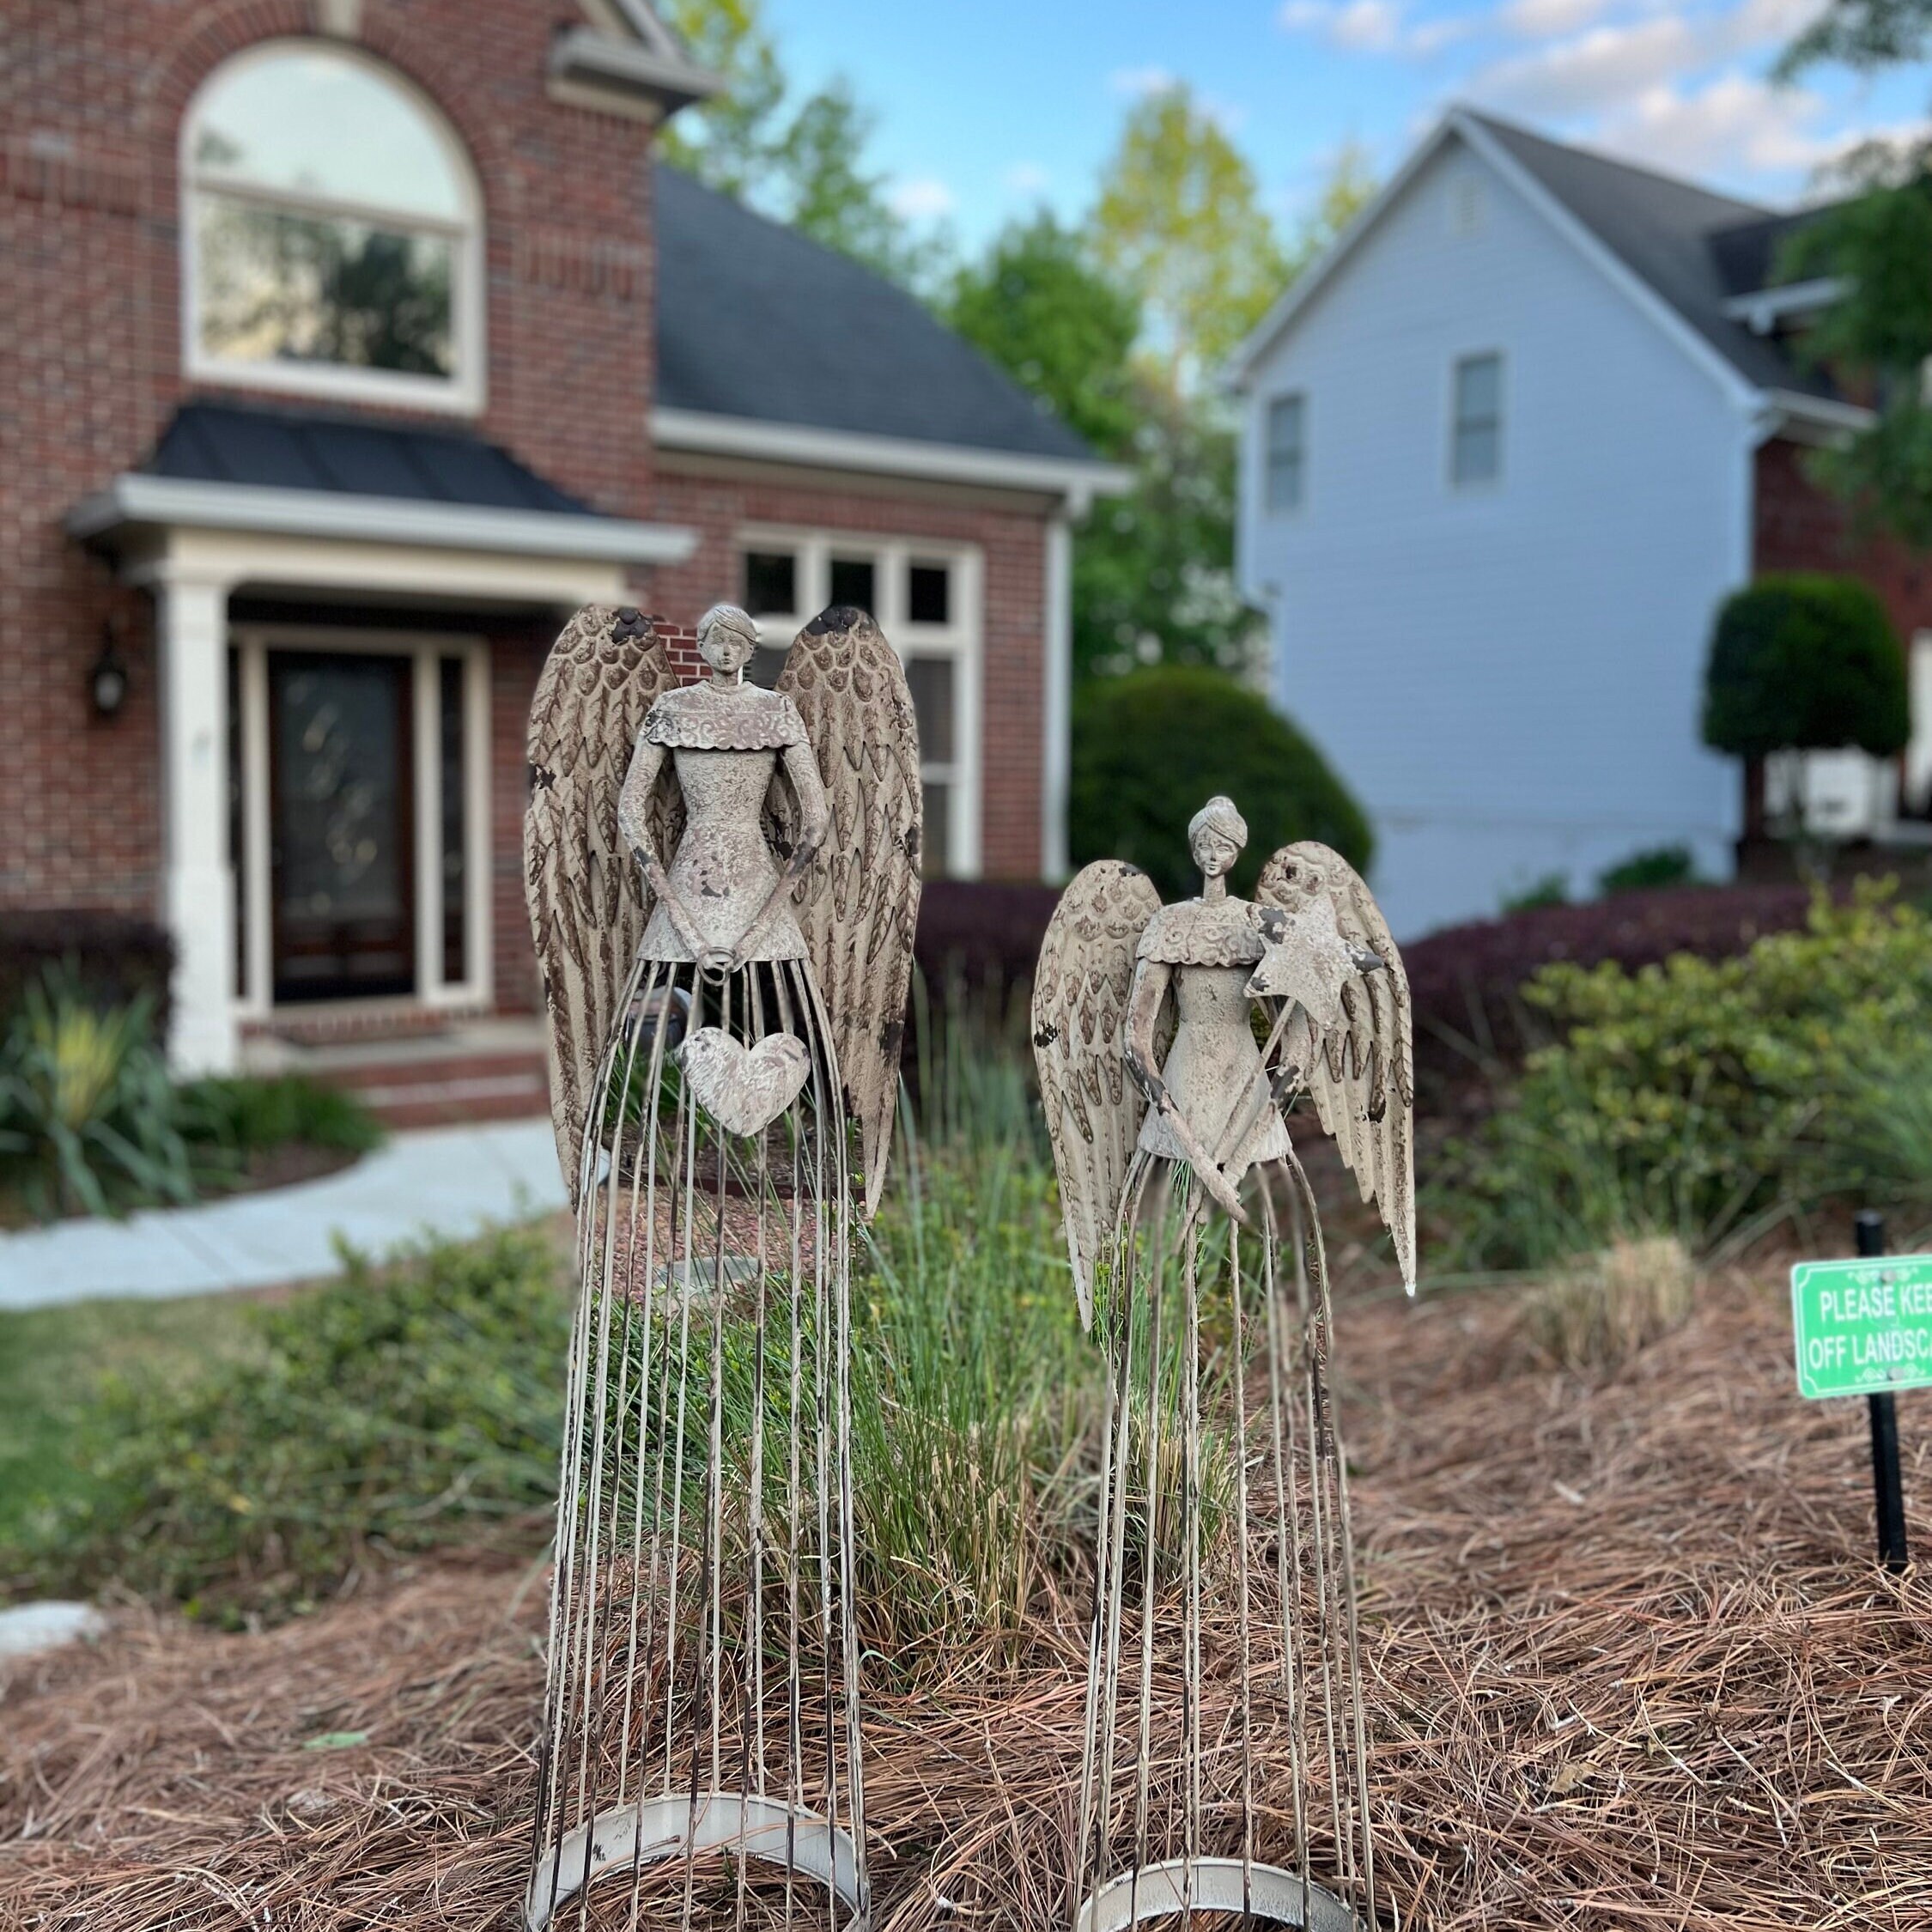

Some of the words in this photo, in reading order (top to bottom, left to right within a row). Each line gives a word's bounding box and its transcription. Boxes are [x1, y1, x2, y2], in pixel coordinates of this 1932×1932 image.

[1820, 1285, 1896, 1322] PLEASE
[1808, 1334, 1846, 1370] OFF
[1852, 1327, 1932, 1365] LANDSC
